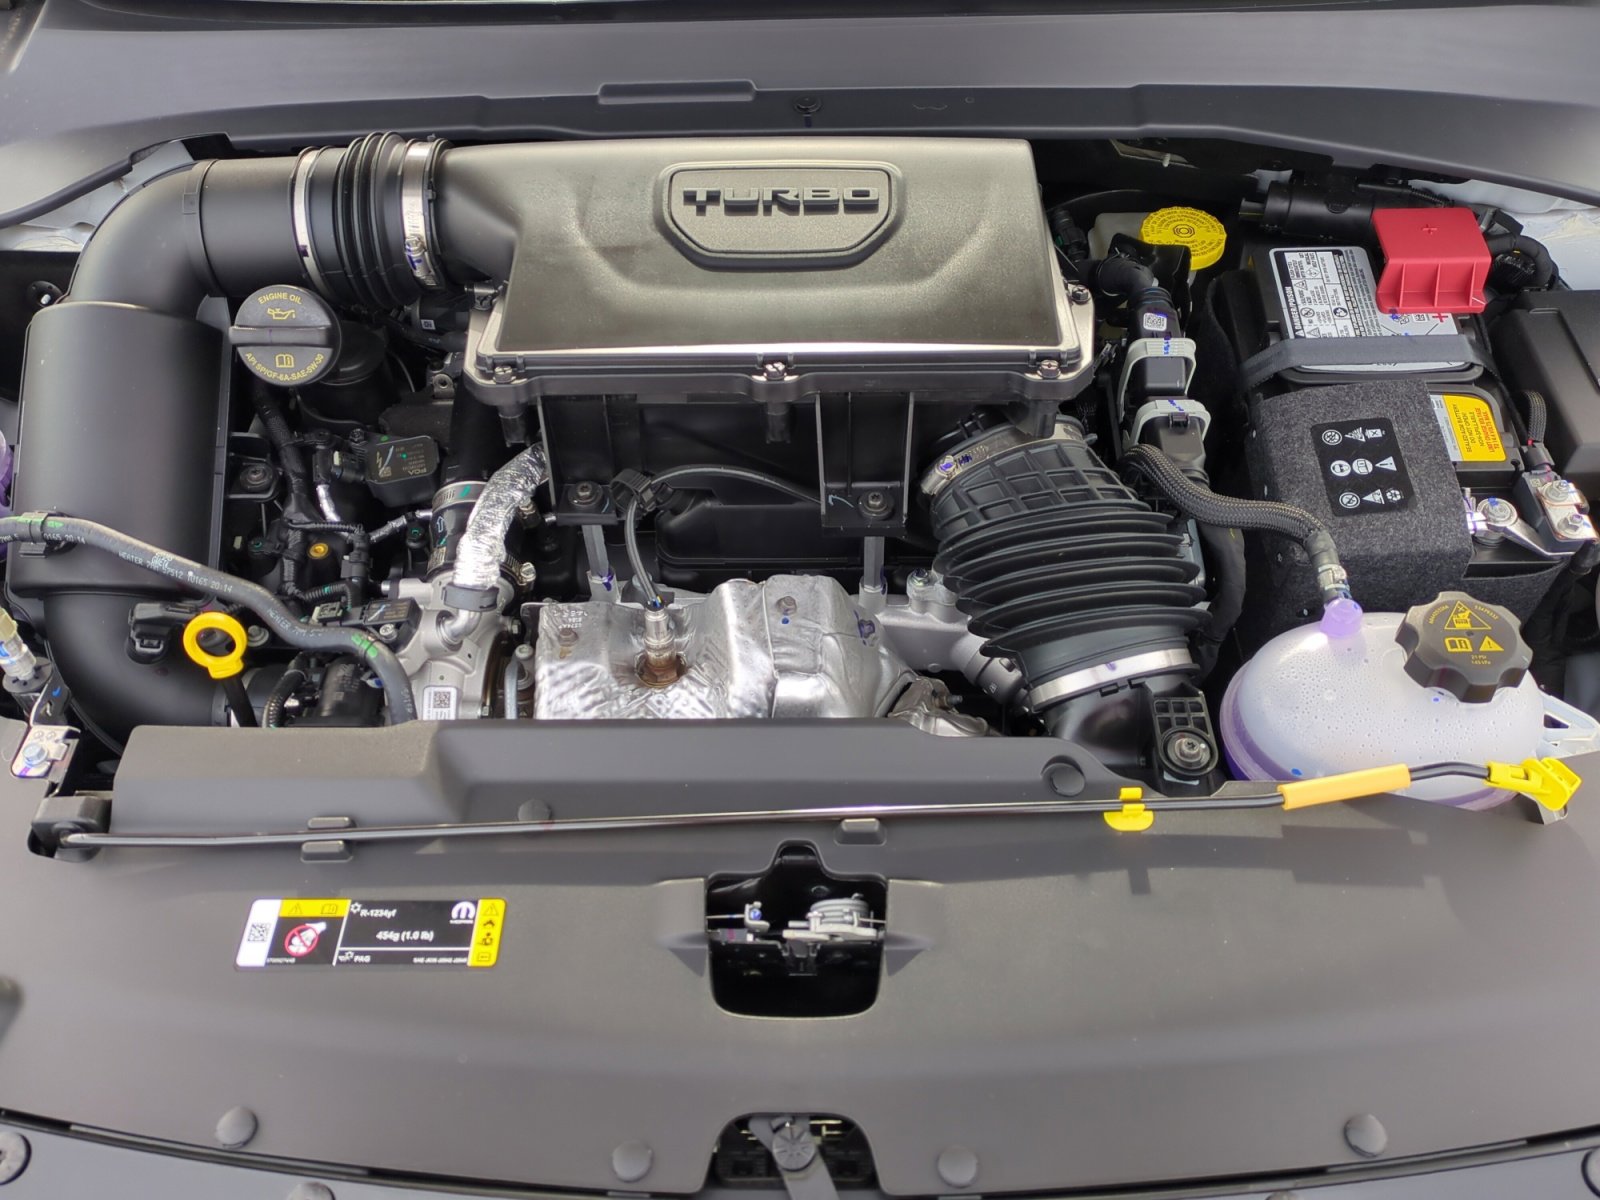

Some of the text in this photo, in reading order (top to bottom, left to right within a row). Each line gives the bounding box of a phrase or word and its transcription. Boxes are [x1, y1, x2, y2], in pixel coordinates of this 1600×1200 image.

[683, 187, 879, 216] TURBO
[258, 292, 303, 305] ENGINE OIL
[1284, 286, 1301, 329] DANGER/POISON
[245, 352, 257, 366] API
[119, 551, 143, 566] HEATER
[360, 909, 397, 919] R-1234yf
[376, 931, 400, 942] 454g
[420, 930, 434, 942] lb)
